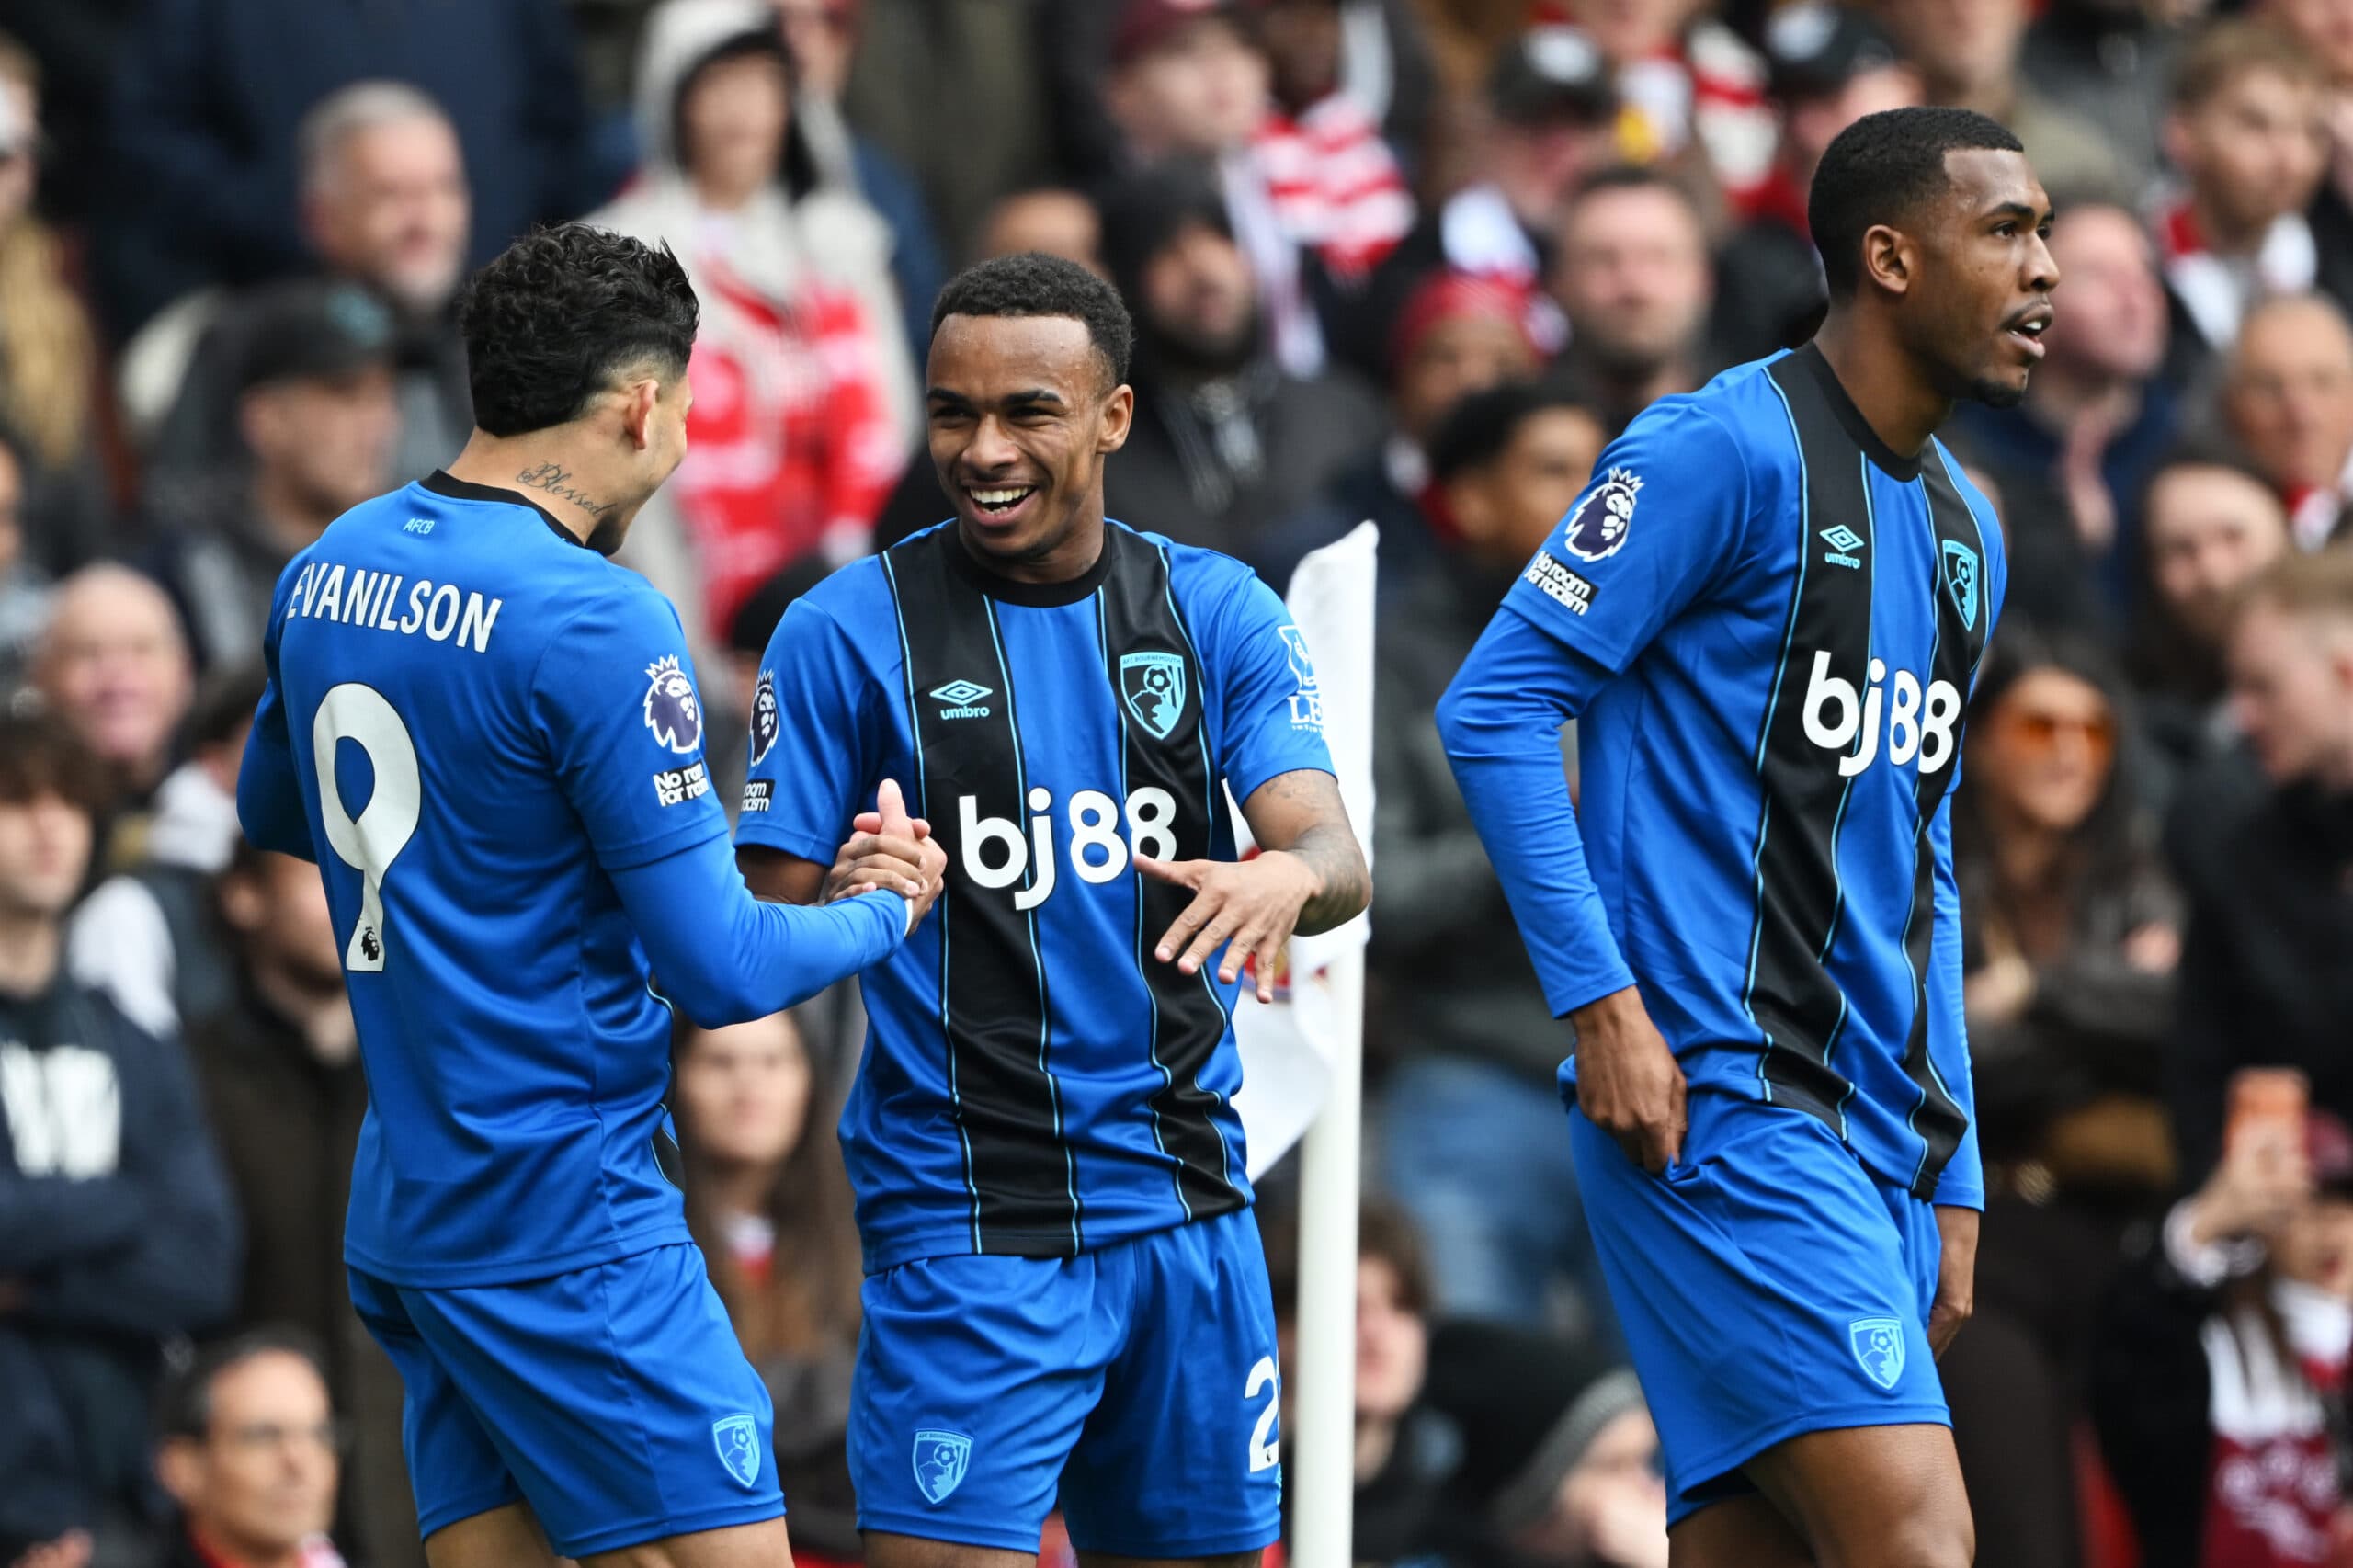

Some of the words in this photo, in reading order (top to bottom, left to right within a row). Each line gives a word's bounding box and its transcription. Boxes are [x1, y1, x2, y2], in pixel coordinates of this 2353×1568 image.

[516, 460, 618, 516] Blessed
[404, 518, 435, 534] AFCB
[1824, 552, 1861, 569] umbro
[1548, 563, 1591, 598] room
[287, 562, 503, 653] EVANILSON
[940, 705, 990, 720] umbro
[1802, 650, 1961, 778] bj88
[653, 771, 682, 790] No
[658, 786, 684, 807] for
[313, 682, 421, 971] 9
[959, 787, 1176, 911] bj88
